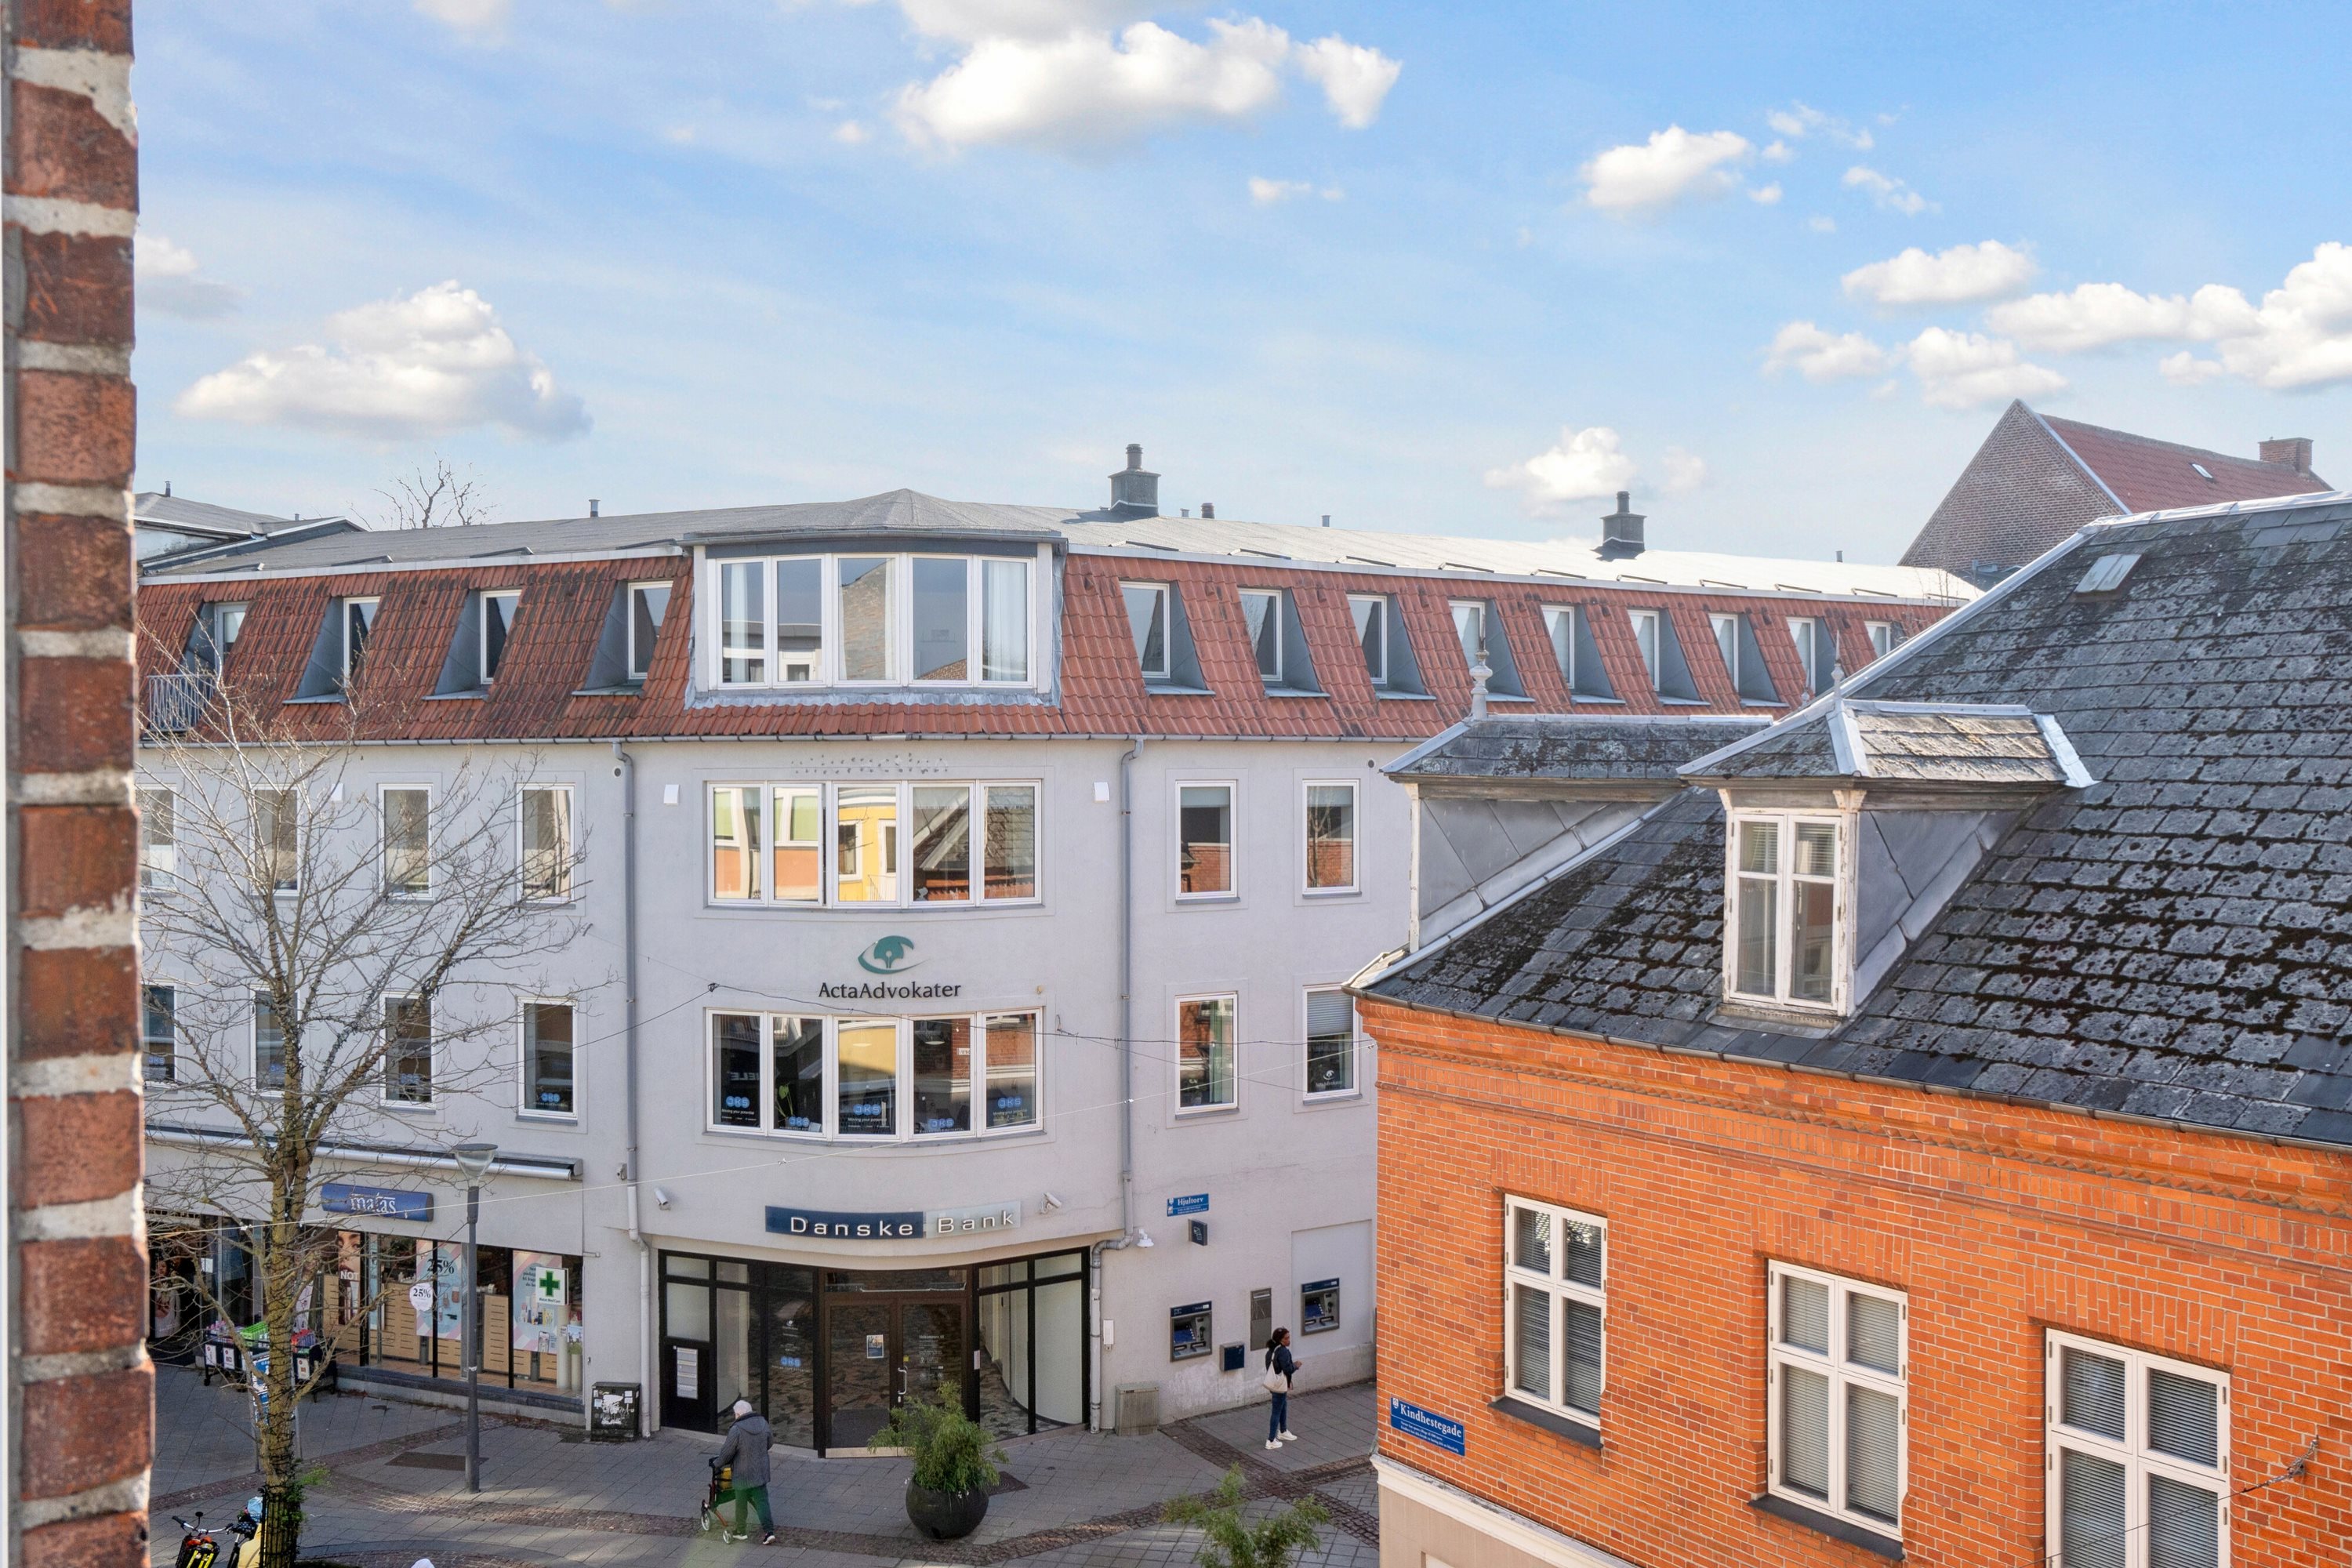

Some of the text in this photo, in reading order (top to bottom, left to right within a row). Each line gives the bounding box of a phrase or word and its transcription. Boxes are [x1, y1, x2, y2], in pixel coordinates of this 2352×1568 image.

[818, 982, 961, 999] ActaAdvokater
[728, 1098, 749, 1107] JKS
[999, 1098, 1021, 1107] JKS
[855, 1105, 880, 1113] JKS
[789, 1117, 808, 1127] JKS
[931, 1119, 953, 1127] JKS
[350, 1192, 396, 1214] matas
[1178, 1197, 1203, 1206] Hjultorv
[790, 1210, 1014, 1236] Danske Bank
[426, 1258, 454, 1274] 25%
[412, 1288, 431, 1298] 25%
[1400, 1403, 1461, 1438] Kindhestegade
